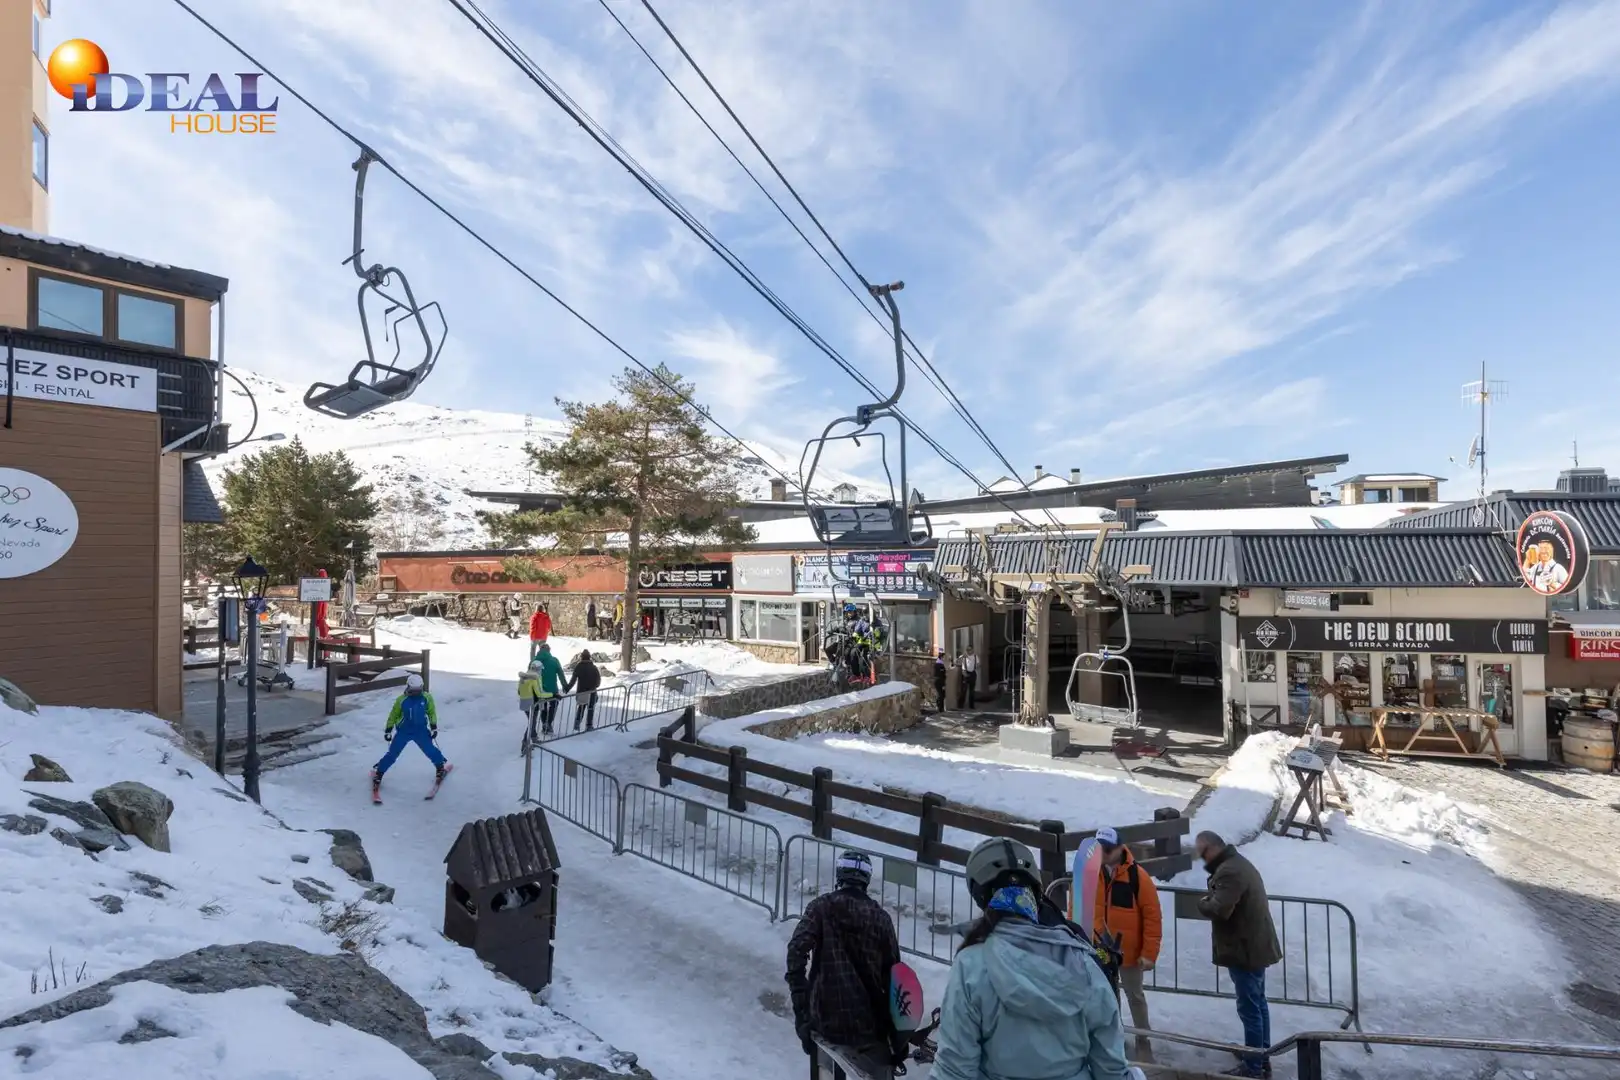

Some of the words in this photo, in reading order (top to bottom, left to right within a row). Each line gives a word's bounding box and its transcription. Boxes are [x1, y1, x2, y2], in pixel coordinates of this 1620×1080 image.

[55, 364, 140, 389] SPORT
[34, 383, 95, 399] RENTAL
[23, 517, 69, 536] Sport
[657, 570, 727, 582] RESET
[1324, 621, 1352, 641] THE
[1357, 622, 1390, 641] NEW
[1395, 622, 1455, 642] SCHOOL
